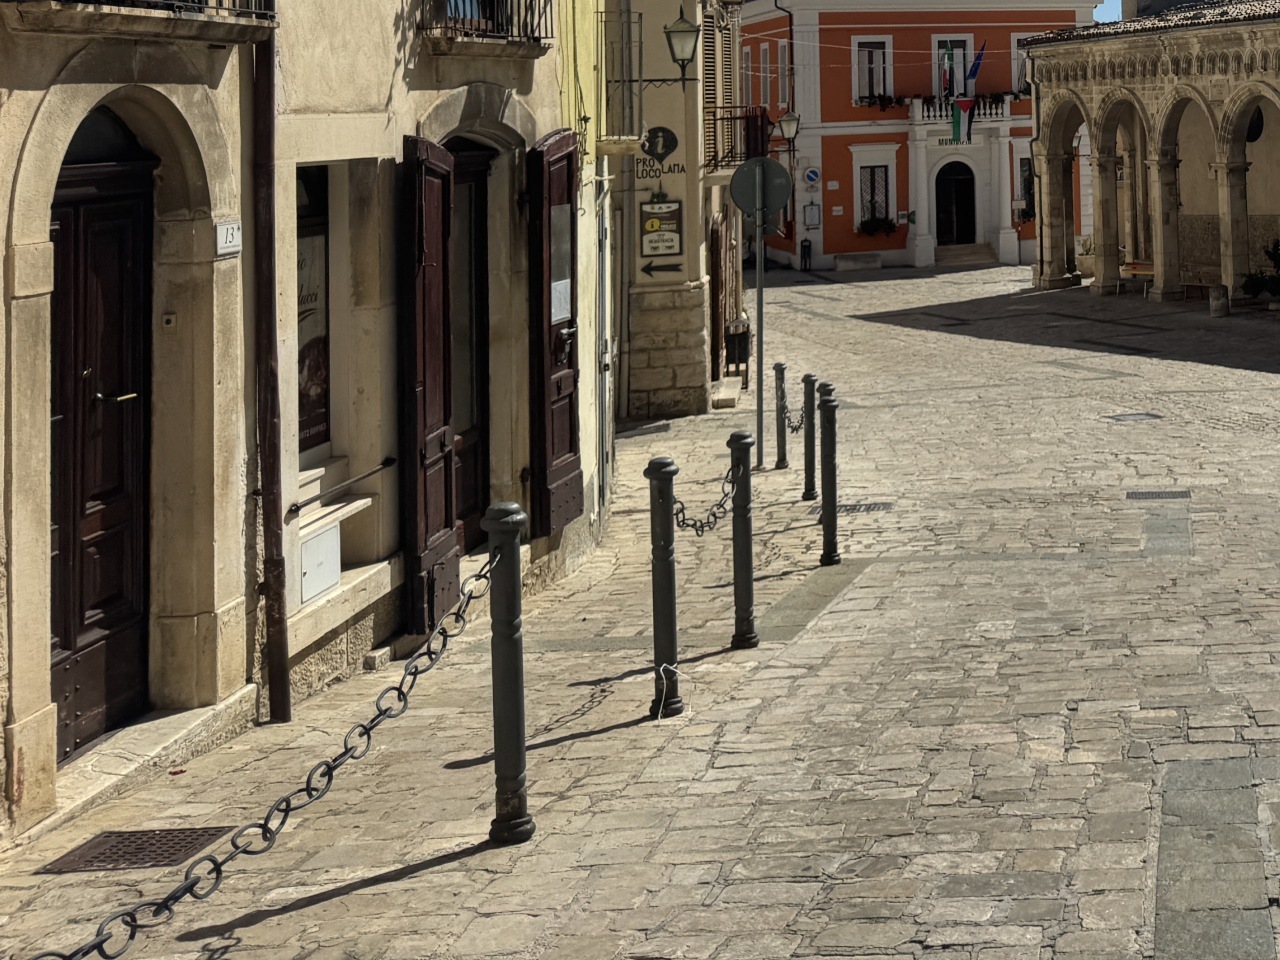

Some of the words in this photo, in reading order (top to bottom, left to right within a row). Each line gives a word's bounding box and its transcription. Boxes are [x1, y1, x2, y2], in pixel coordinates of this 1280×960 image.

[636, 157, 655, 169] PRO
[636, 167, 662, 179] LOCO
[224, 226, 235, 245] 13
